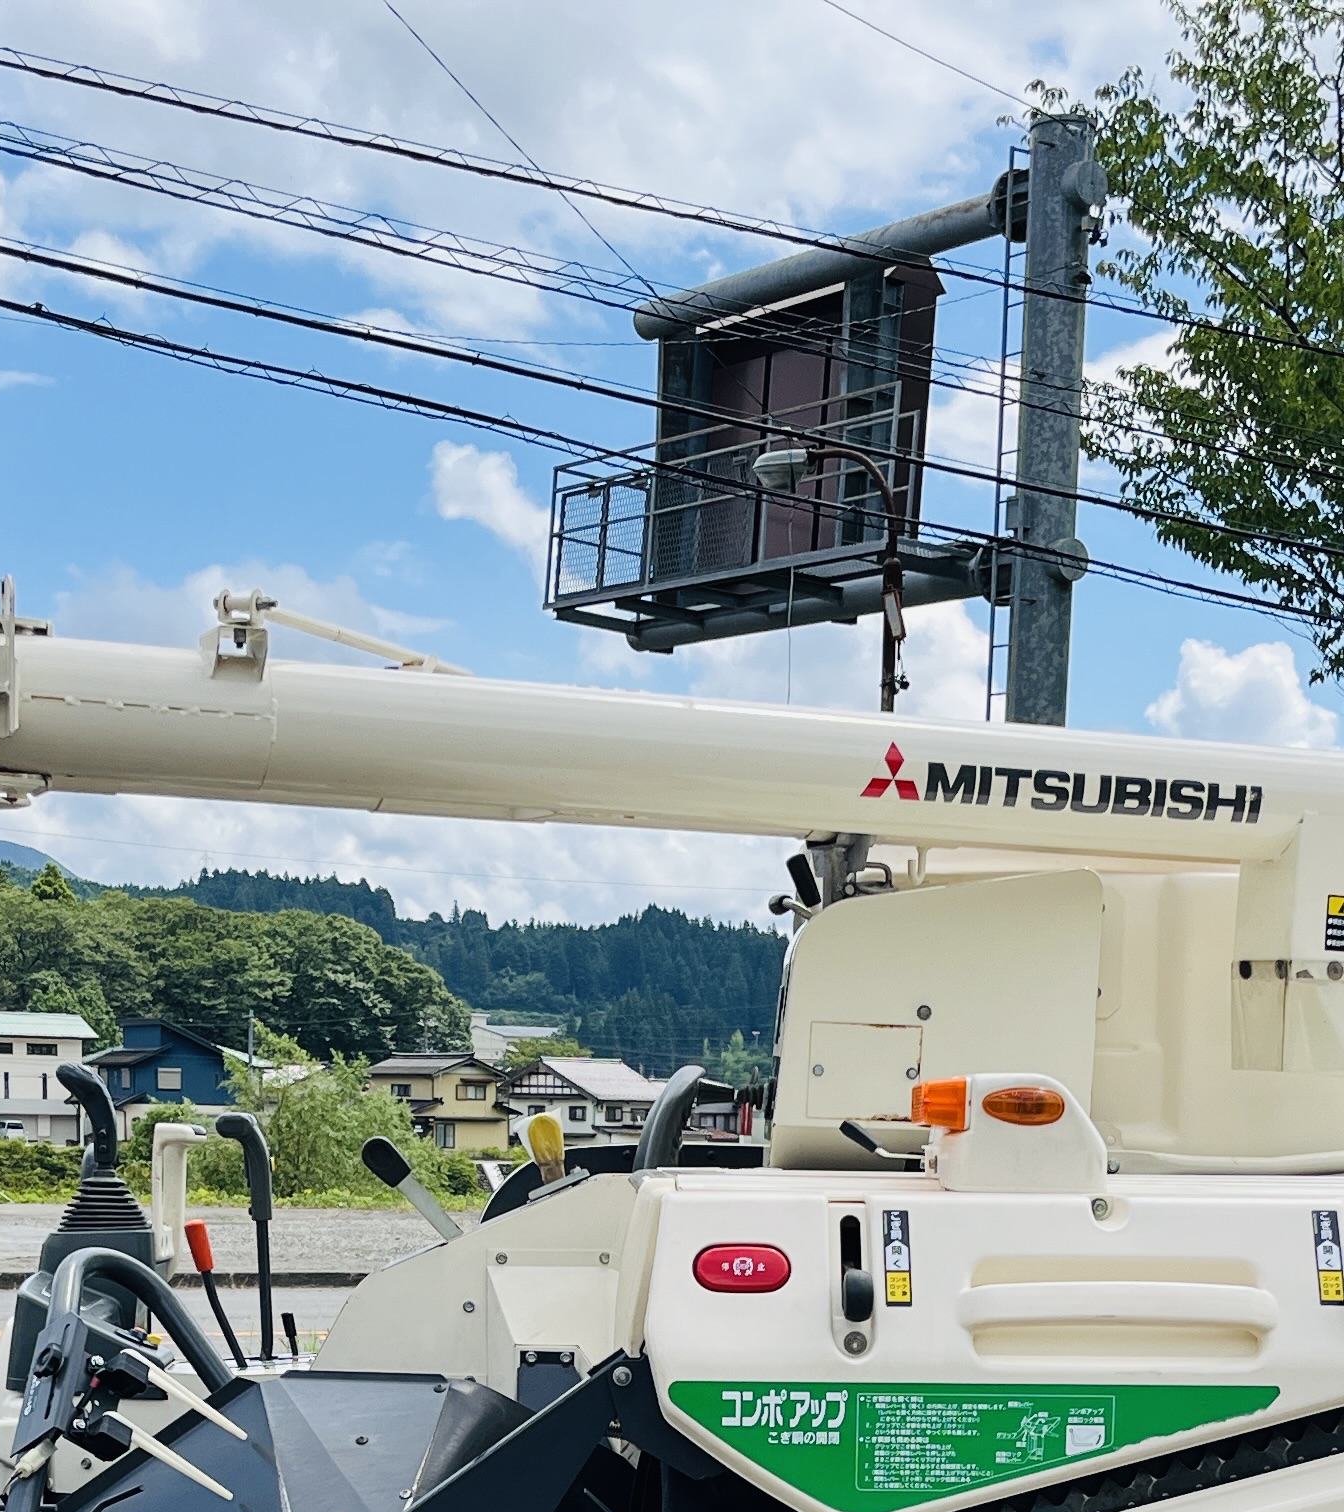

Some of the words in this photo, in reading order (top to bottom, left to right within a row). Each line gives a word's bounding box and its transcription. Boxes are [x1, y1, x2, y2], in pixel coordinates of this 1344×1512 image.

[924, 761, 1264, 824] MITSUBISHI
[721, 1388, 849, 1429] コンポアップ
